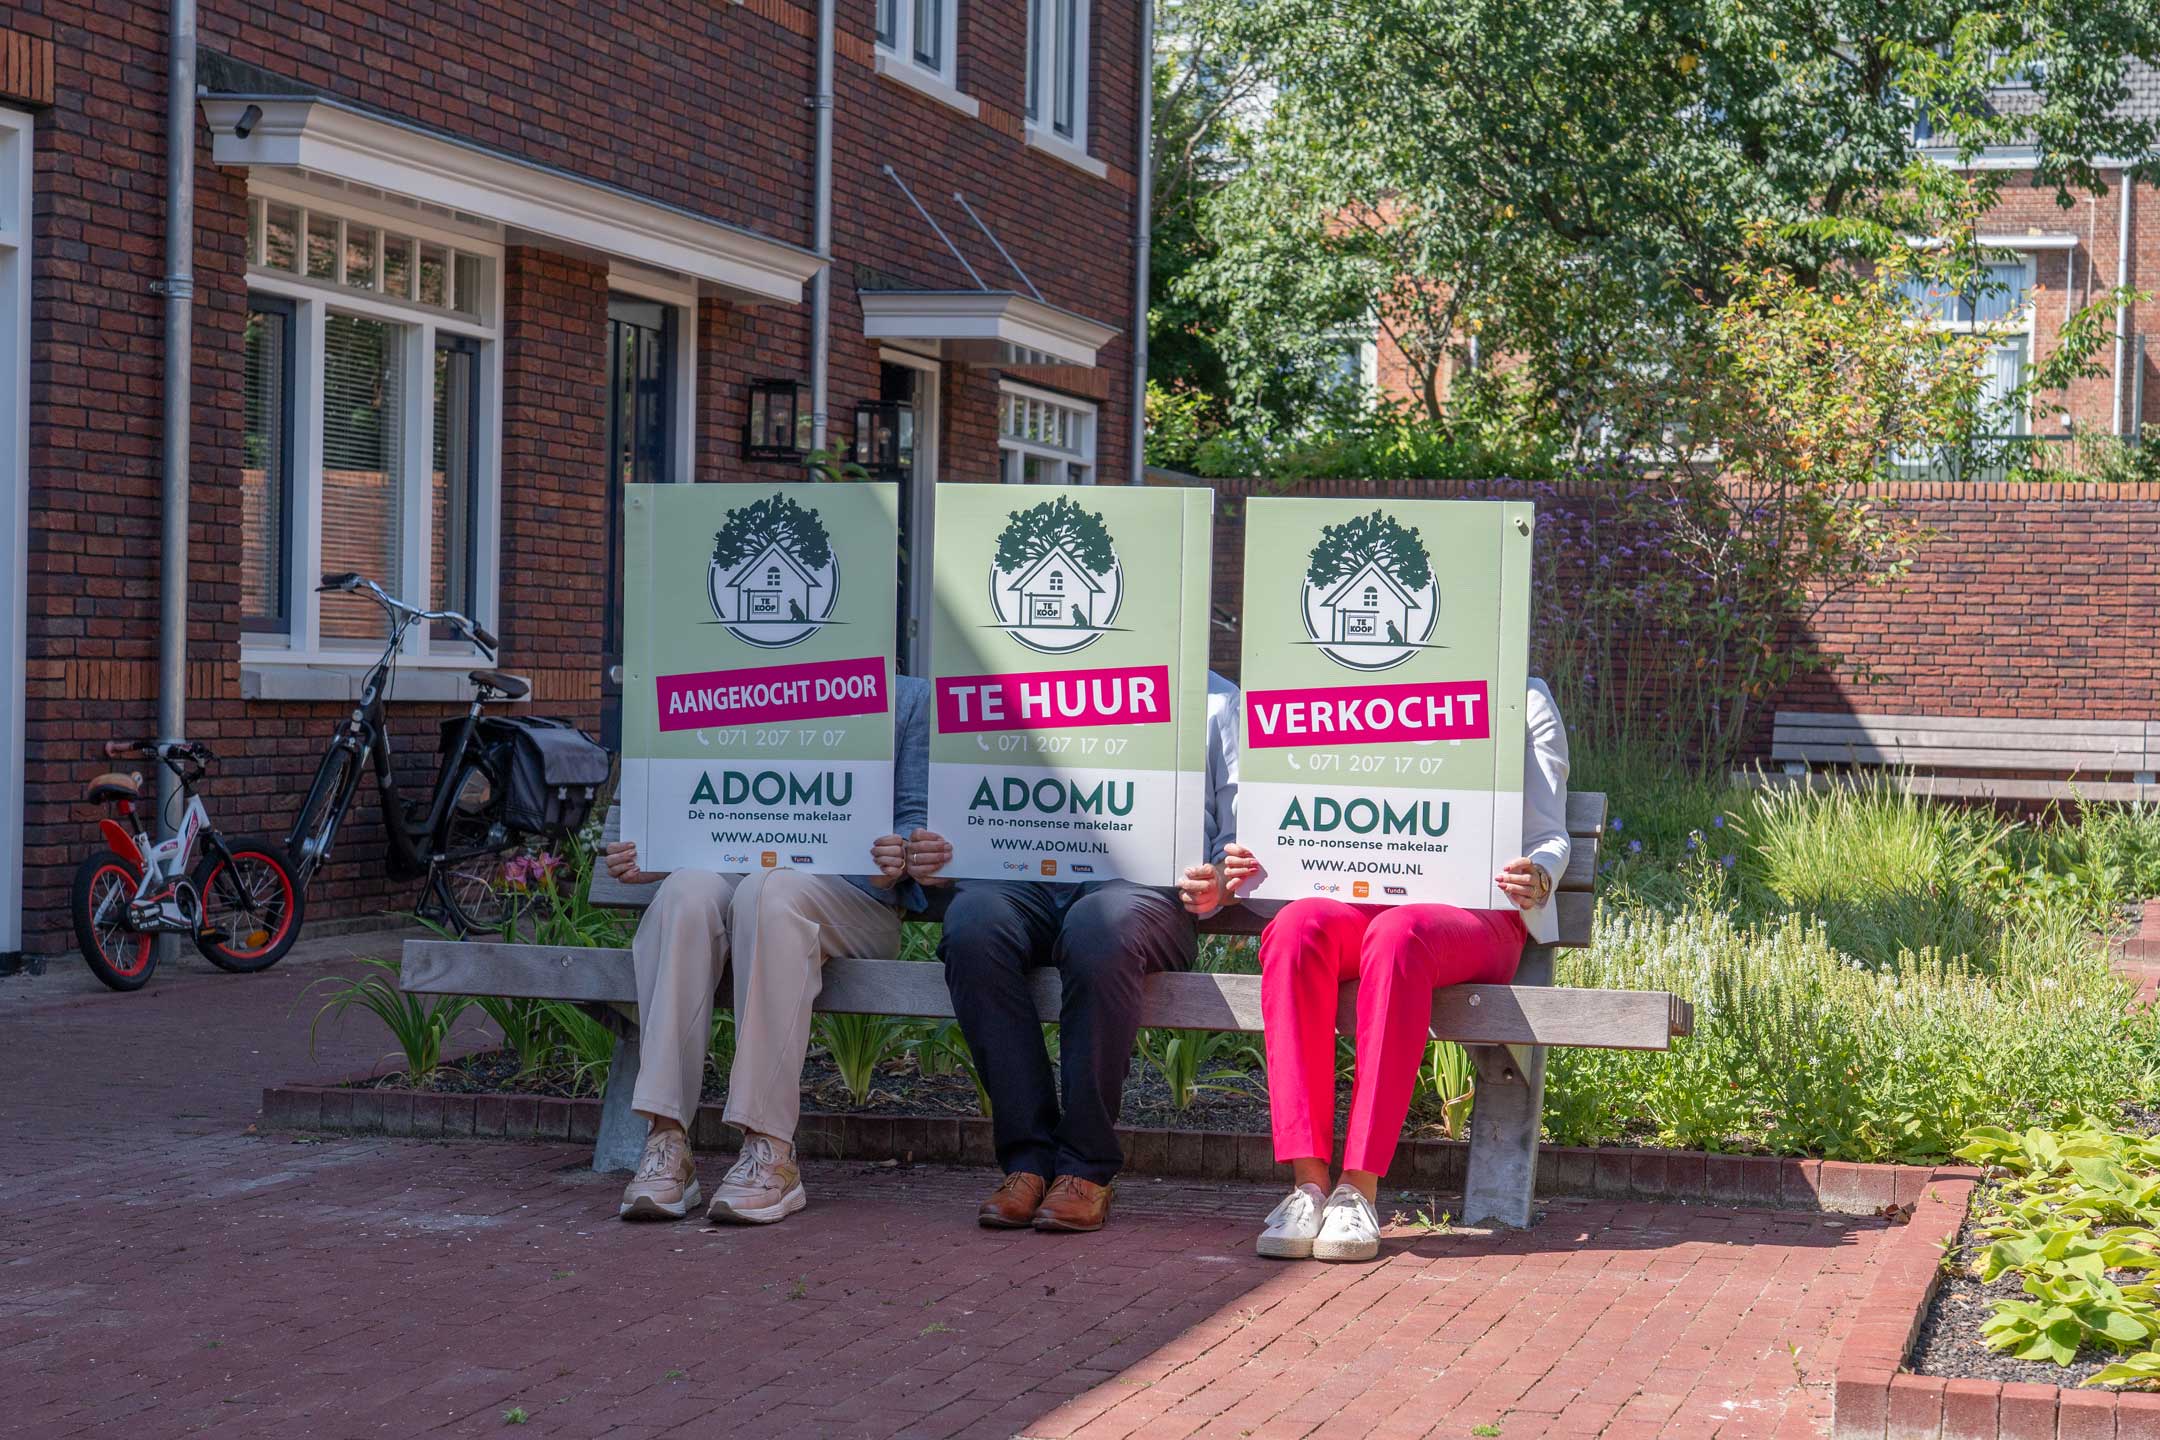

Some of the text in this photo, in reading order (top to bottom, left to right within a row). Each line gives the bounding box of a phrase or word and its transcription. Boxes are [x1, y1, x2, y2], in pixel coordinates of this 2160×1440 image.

[669, 674, 877, 714] AANGEKOCHT DOOR
[949, 676, 1157, 722] TE HUUR
[1254, 693, 1481, 735] VERKOCHT
[718, 729, 846, 747] 071 207 17 07
[998, 734, 1128, 755] 071 207 17 07
[1309, 753, 1443, 775] 071 207 17 07
[689, 771, 852, 806] ADOMU
[968, 776, 1134, 817] ADOMU
[688, 809, 852, 822] Dè no-nonsense makelaar
[968, 815, 1133, 832] Dè no-nonsense makelaar
[1279, 795, 1450, 837] ADOMU
[711, 831, 828, 844] WWW.ADOMU.NL
[991, 838, 1109, 854] WWW.ADOMU.NL
[1278, 836, 1449, 853] Dè no-nonsense makelaar
[723, 854, 749, 863] Google
[1003, 861, 1029, 871] Google
[1301, 859, 1423, 875] WWW.ADOMU.NL
[1313, 882, 1340, 893] Google
